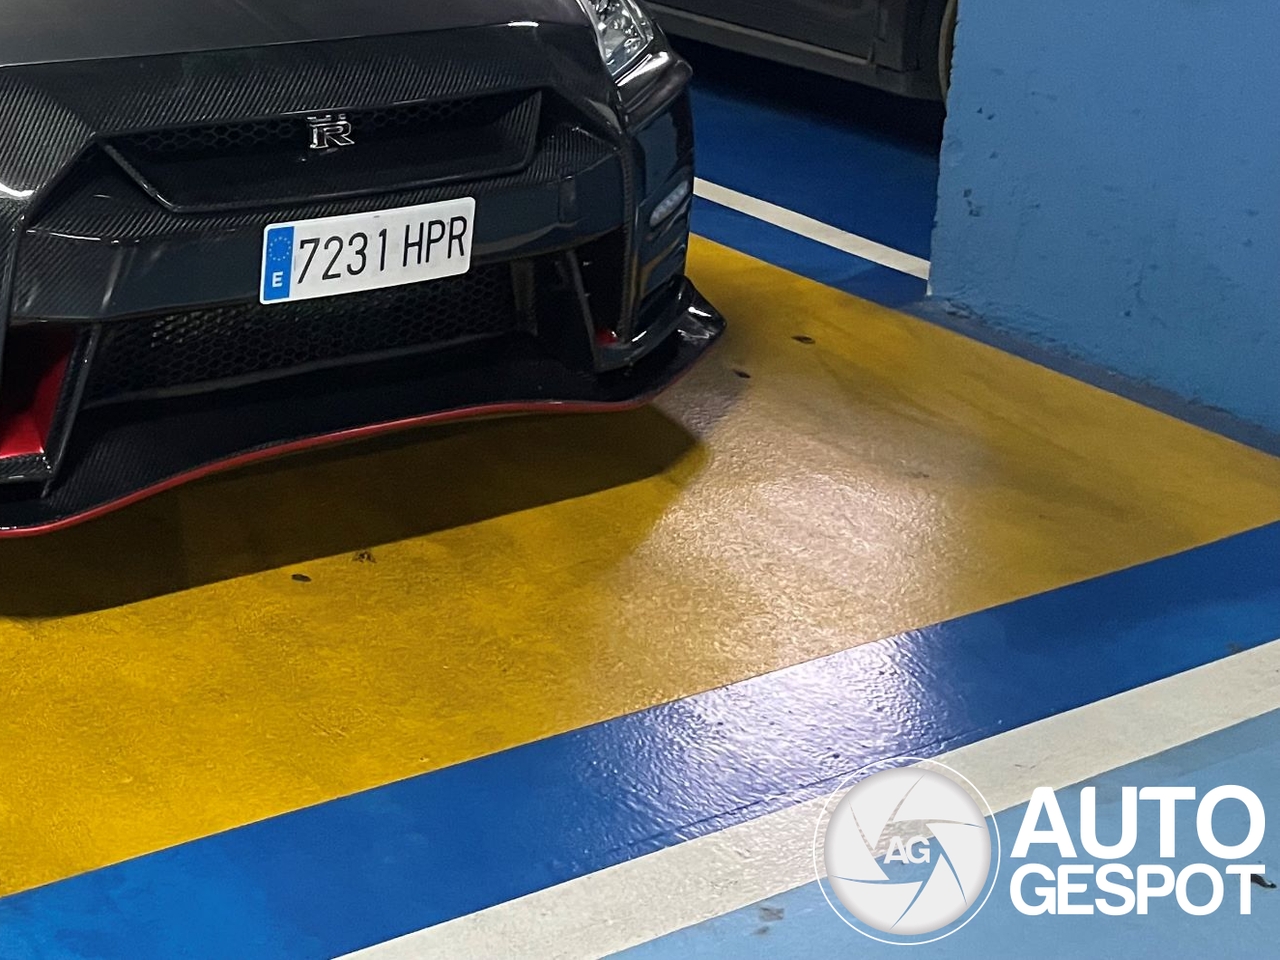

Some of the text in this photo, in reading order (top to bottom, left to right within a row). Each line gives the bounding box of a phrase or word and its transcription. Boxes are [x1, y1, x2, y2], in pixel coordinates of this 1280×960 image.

[297, 215, 468, 284] 7231 HPR
[271, 271, 283, 287] E
